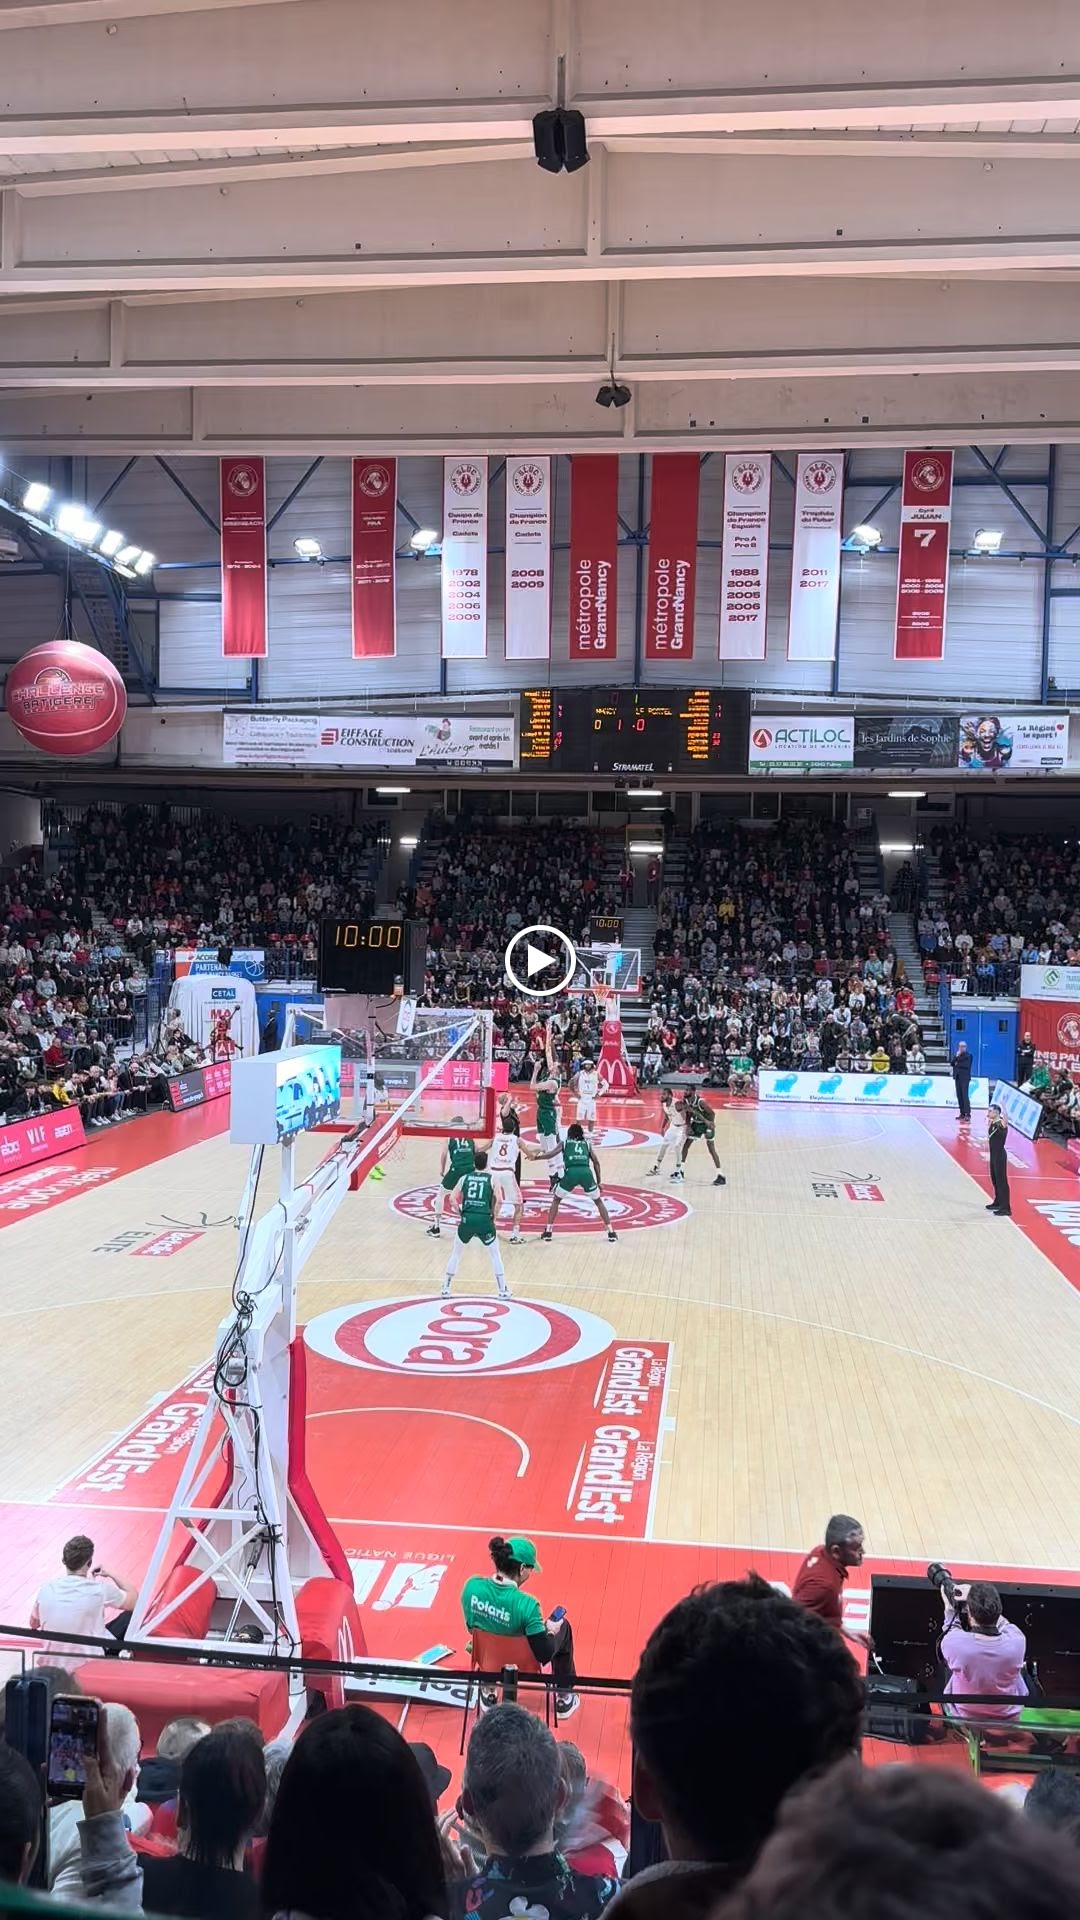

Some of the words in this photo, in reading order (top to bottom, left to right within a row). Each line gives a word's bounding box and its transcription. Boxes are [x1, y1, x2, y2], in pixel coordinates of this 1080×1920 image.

[510, 512, 547, 520] Champion
[914, 529, 936, 547] 7
[448, 580, 480, 588] 2002
[511, 580, 544, 588] 2009
[727, 580, 762, 588] 2004
[800, 580, 829, 588] 2017
[448, 602, 480, 610] 2006
[576, 560, 592, 650] métropole
[593, 560, 612, 650] GrandNancy
[652, 558, 670, 650] métropole
[670, 560, 690, 650] GrandNancy
[726, 603, 761, 611] 2006
[448, 613, 480, 621] 2009
[728, 614, 758, 622] 2017
[594, 720, 602, 730] 0
[340, 728, 383, 738] EIFFAGE
[775, 729, 851, 743] ACTILOC
[340, 738, 414, 748] CONSTRUCTION
[862, 734, 874, 742] les
[875, 734, 907, 745] Jardins
[908, 734, 919, 743] de
[920, 734, 950, 744] Sophie
[612, 762, 654, 771] STRAMATEL
[334, 925, 402, 948] 10:00
[26, 1126, 46, 1144] VIF
[499, 1144, 508, 1156] 8
[574, 1142, 583, 1154] 4
[467, 1181, 484, 1199] 21
[402, 1300, 510, 1365] cora
[601, 1347, 654, 1415] GrandEst
[646, 1366, 666, 1386] Région
[76, 1402, 208, 1492] GrandEst
[637, 1441, 655, 1451] La
[631, 1452, 654, 1480] Région
[575, 1424, 640, 1523] GrandEst
[403, 1552, 455, 1562] LIGUE
[470, 1595, 510, 1622] Polaris
